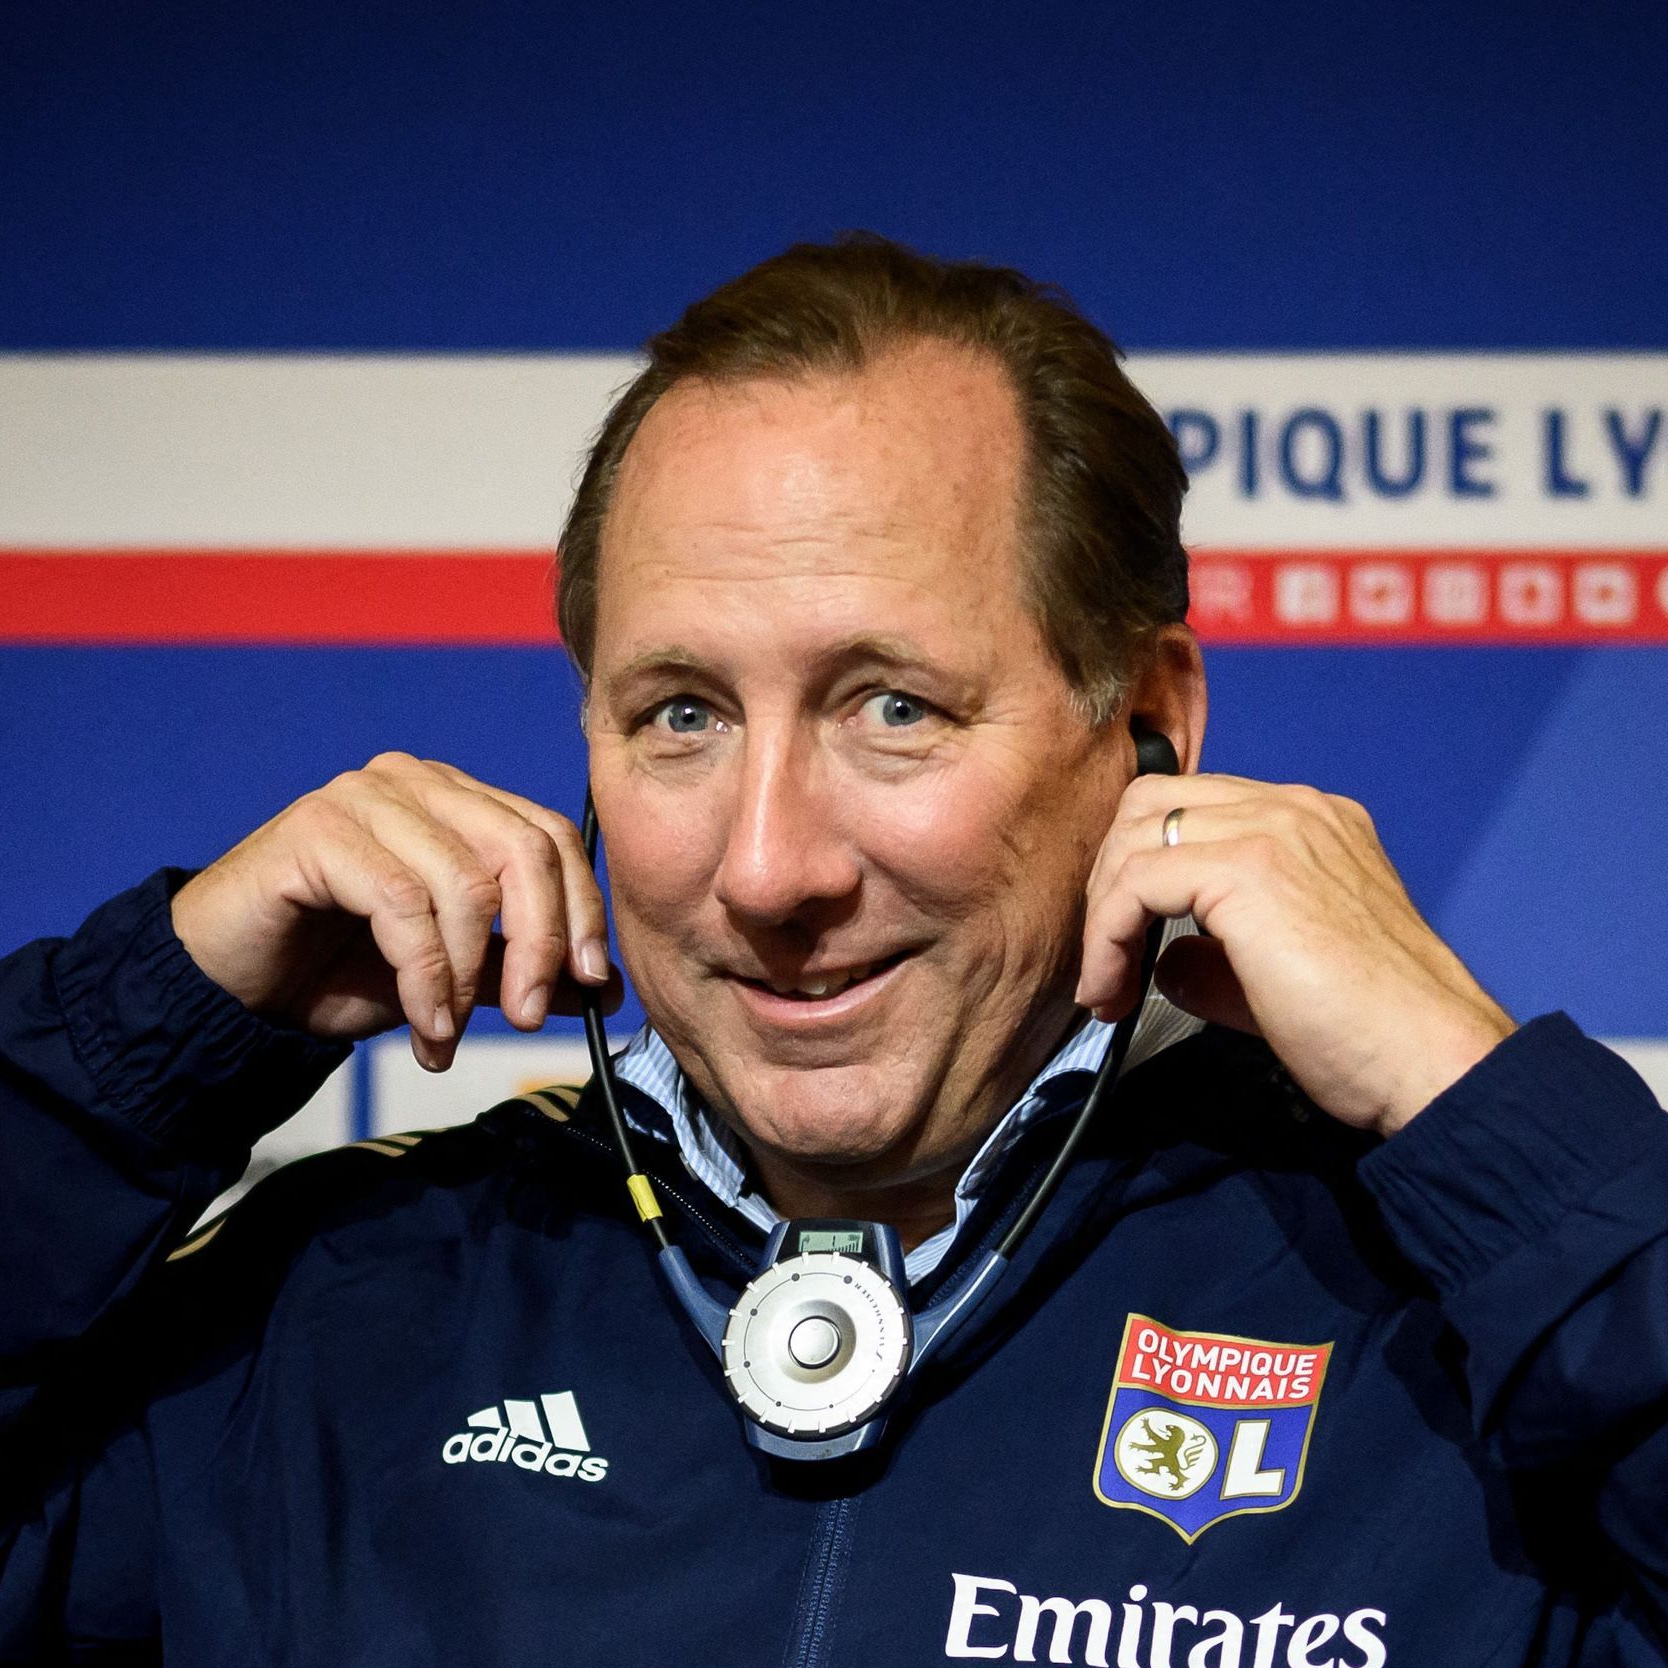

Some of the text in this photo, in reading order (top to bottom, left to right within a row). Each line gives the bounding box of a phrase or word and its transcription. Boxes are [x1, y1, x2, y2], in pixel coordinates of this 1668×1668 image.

[1165, 403, 1500, 505] PIQUE
[1131, 1353, 1312, 1401] LYONNAIS
[1136, 1328, 1318, 1377] OLYMPIQUE
[442, 1425, 610, 1483] adidas
